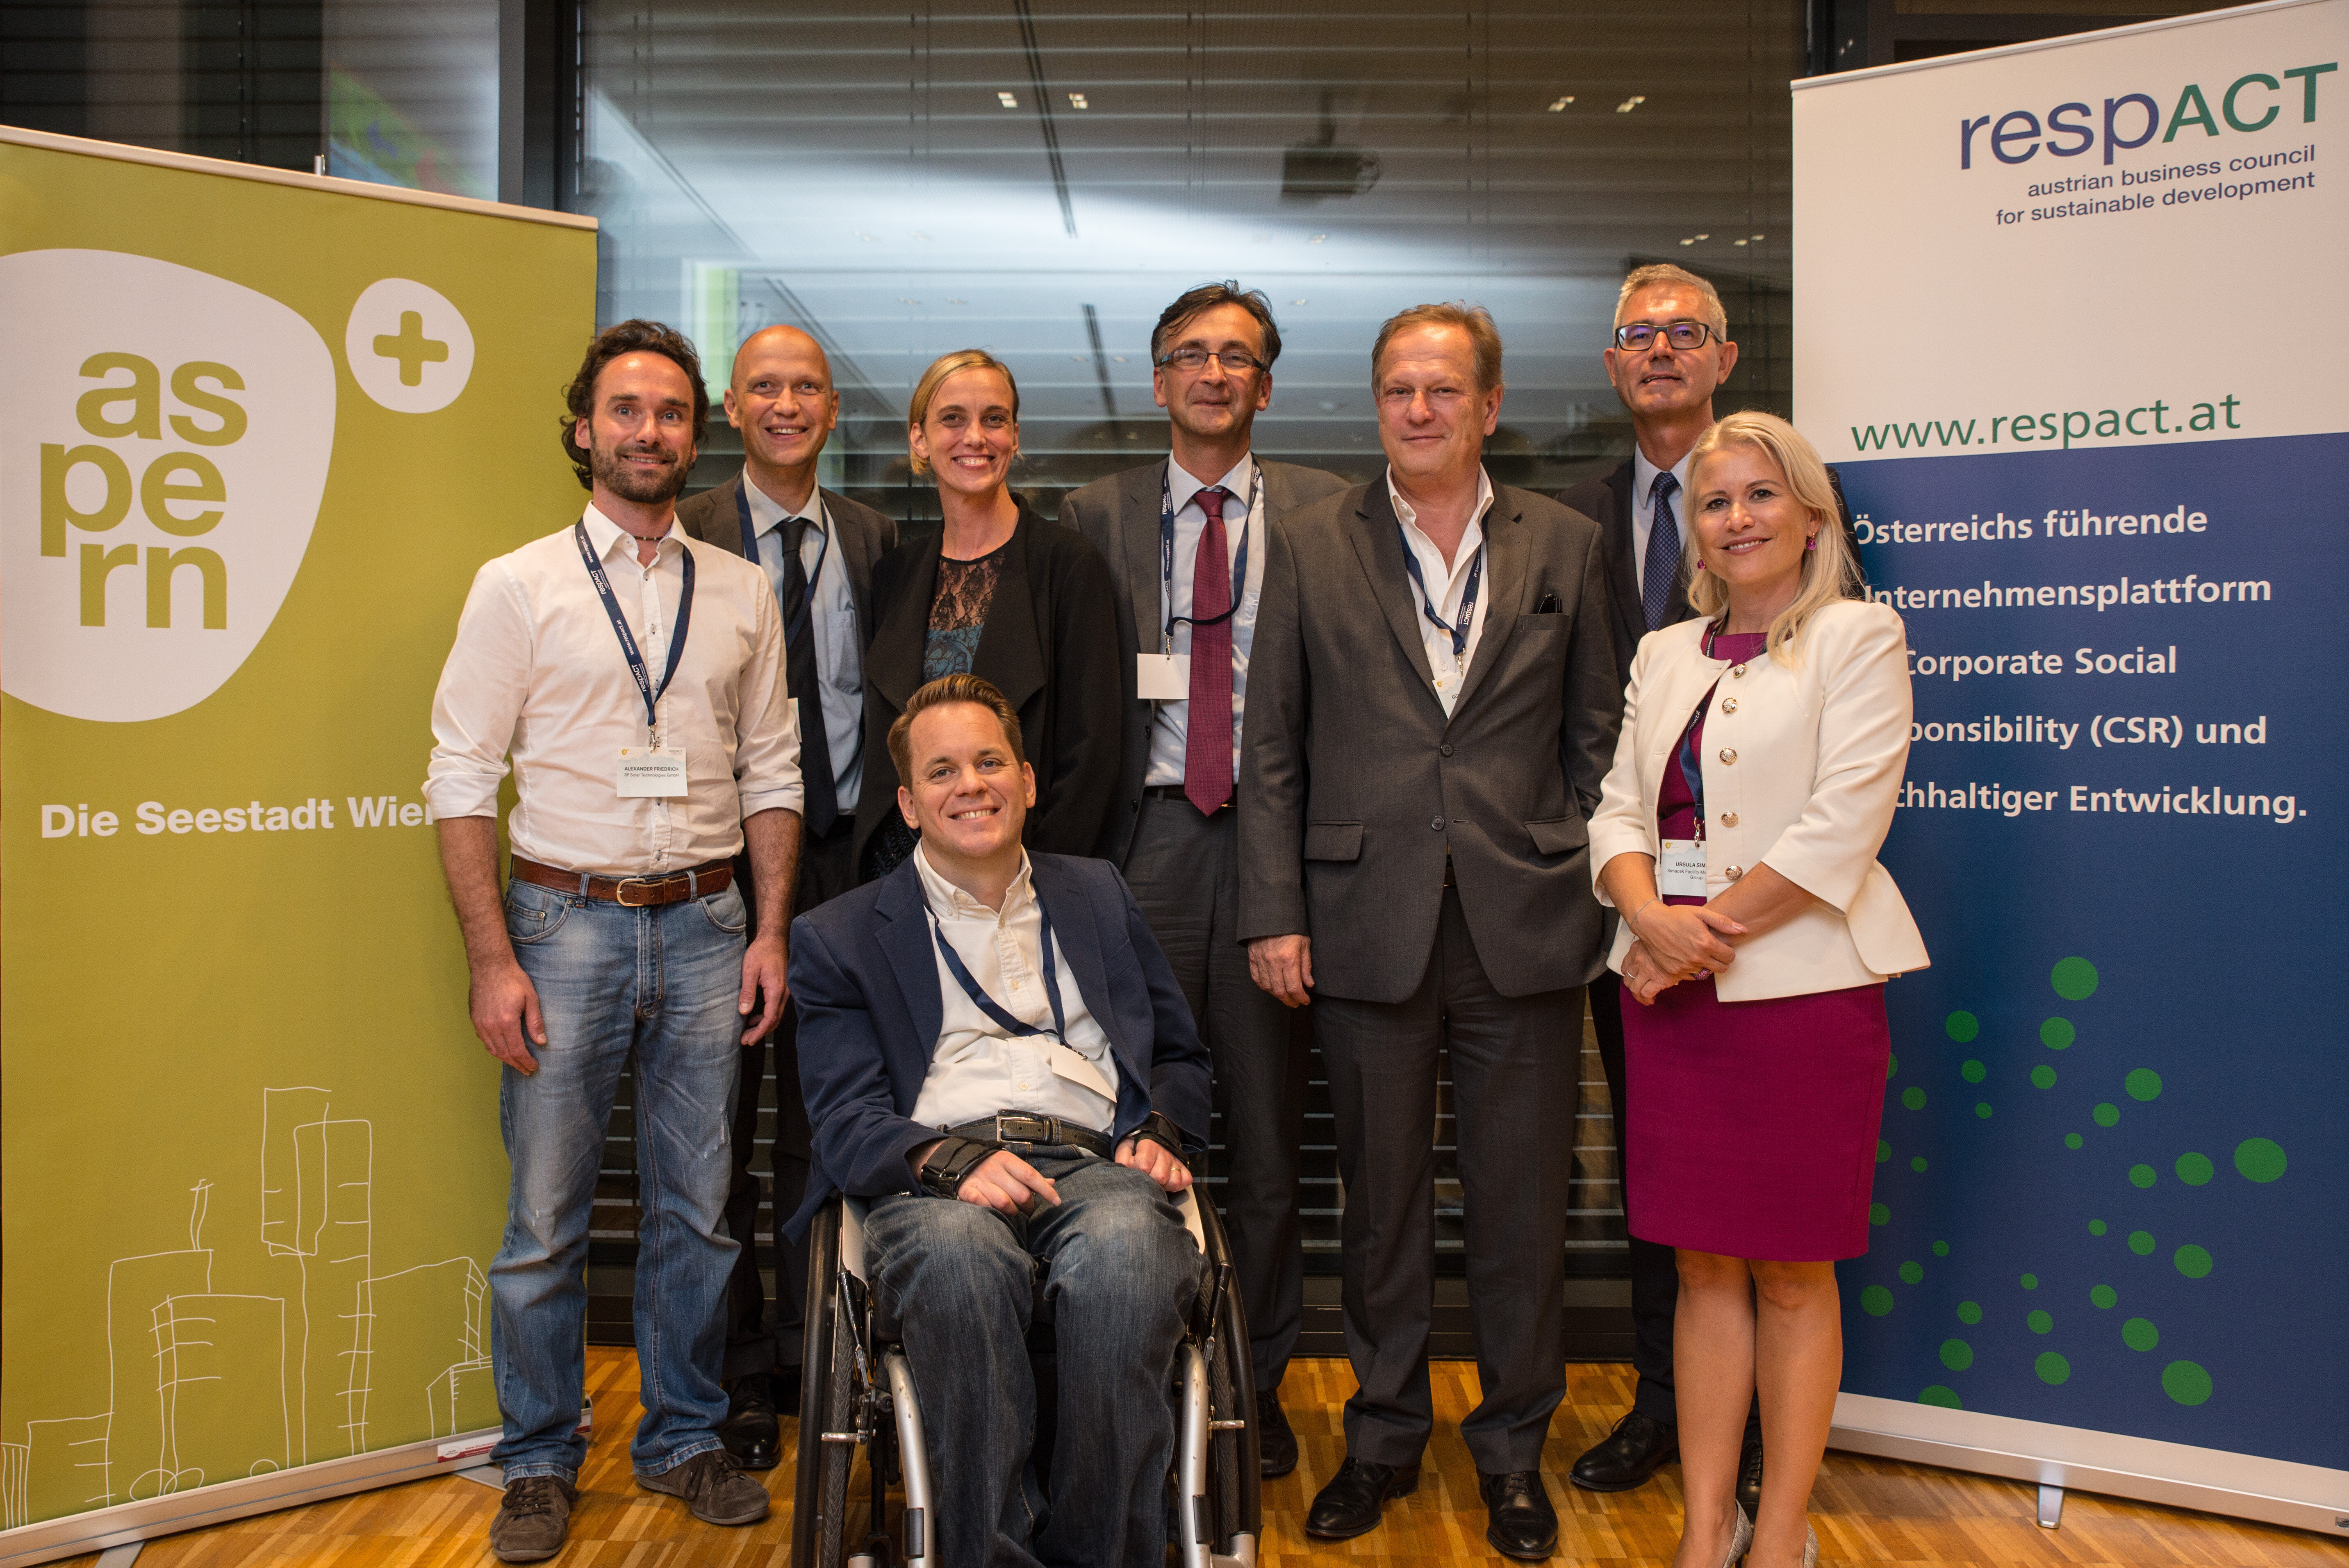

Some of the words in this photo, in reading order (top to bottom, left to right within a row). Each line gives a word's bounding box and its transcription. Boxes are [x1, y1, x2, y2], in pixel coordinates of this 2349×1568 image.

[1961, 62, 2338, 170] respACT
[2028, 175, 2113, 197] austrian
[2122, 164, 2222, 186] business
[2229, 144, 2315, 172] council
[1996, 209, 2025, 225] for
[2031, 193, 2155, 221] sustainable
[2162, 171, 2315, 206] development
[1851, 394, 2240, 451] www.respact.at
[1853, 513, 2033, 544] Österreichs
[2043, 505, 2207, 537] führende
[590, 570, 607, 595] respACT
[1463, 601, 1474, 626] respACT
[631, 664, 646, 692] respACT
[2075, 646, 2176, 674] Social
[1910, 715, 2079, 750] onsibility
[2090, 715, 2183, 748] (CSR)
[2196, 716, 2266, 744] und
[42, 803, 119, 838] Die
[135, 798, 334, 835] Seestadt
[1896, 781, 2058, 817] hhaltiger
[2070, 786, 2306, 824] Entwicklung.
